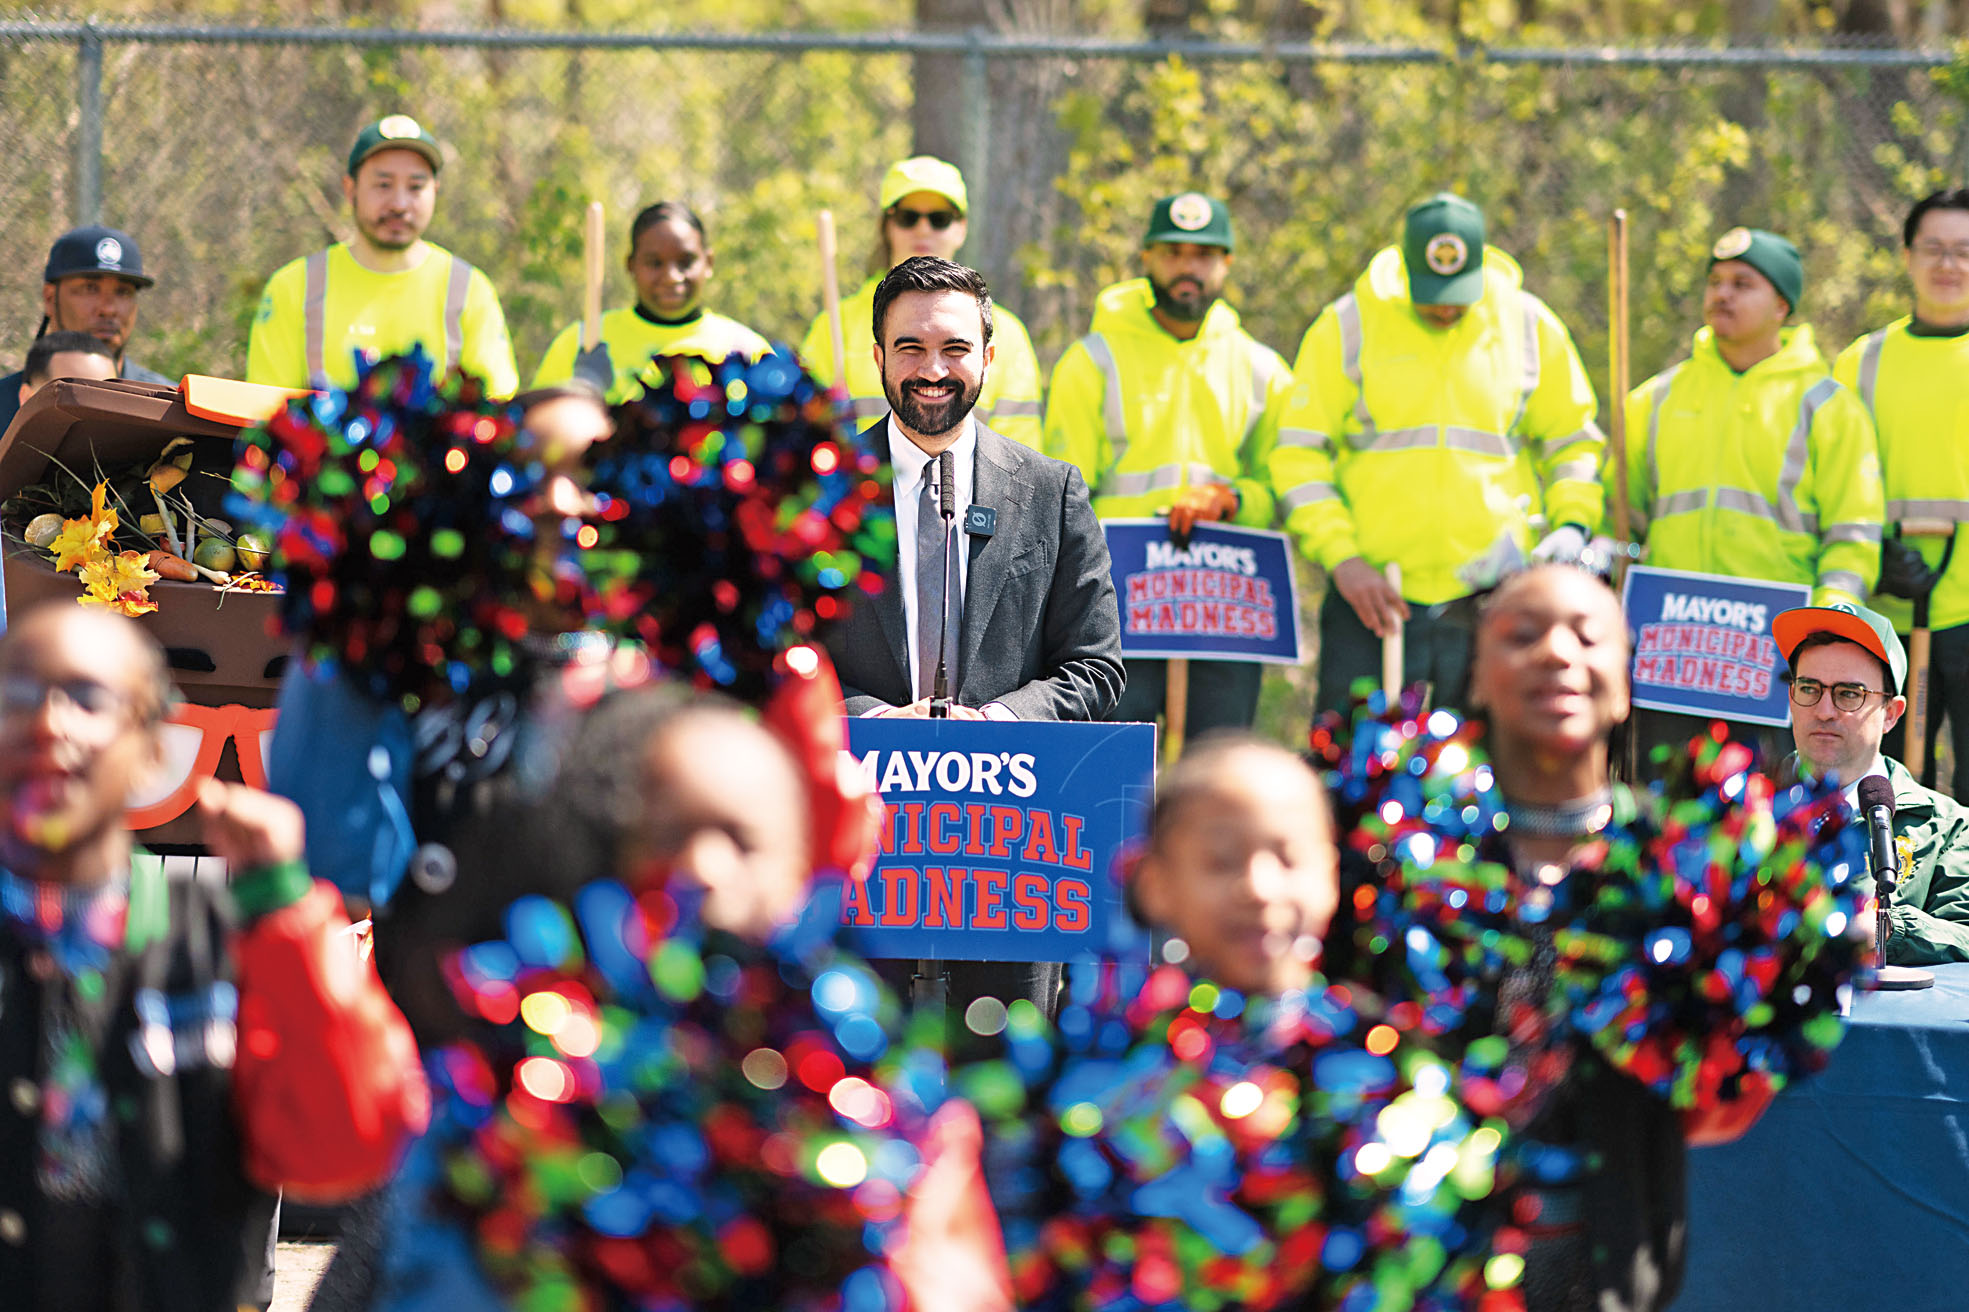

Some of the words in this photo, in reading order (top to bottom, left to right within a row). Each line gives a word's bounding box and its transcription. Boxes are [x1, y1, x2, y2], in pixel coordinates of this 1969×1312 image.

[1126, 569, 1275, 611] MUNICIPAL
[1126, 601, 1277, 638] MADNESS
[1661, 593, 1767, 633] MAYOR'S
[1639, 624, 1776, 669] MUNICIPAL
[1634, 656, 1773, 698] MADNESS
[873, 801, 1093, 873] NICIPAL
[841, 866, 1092, 933] ADNESS
